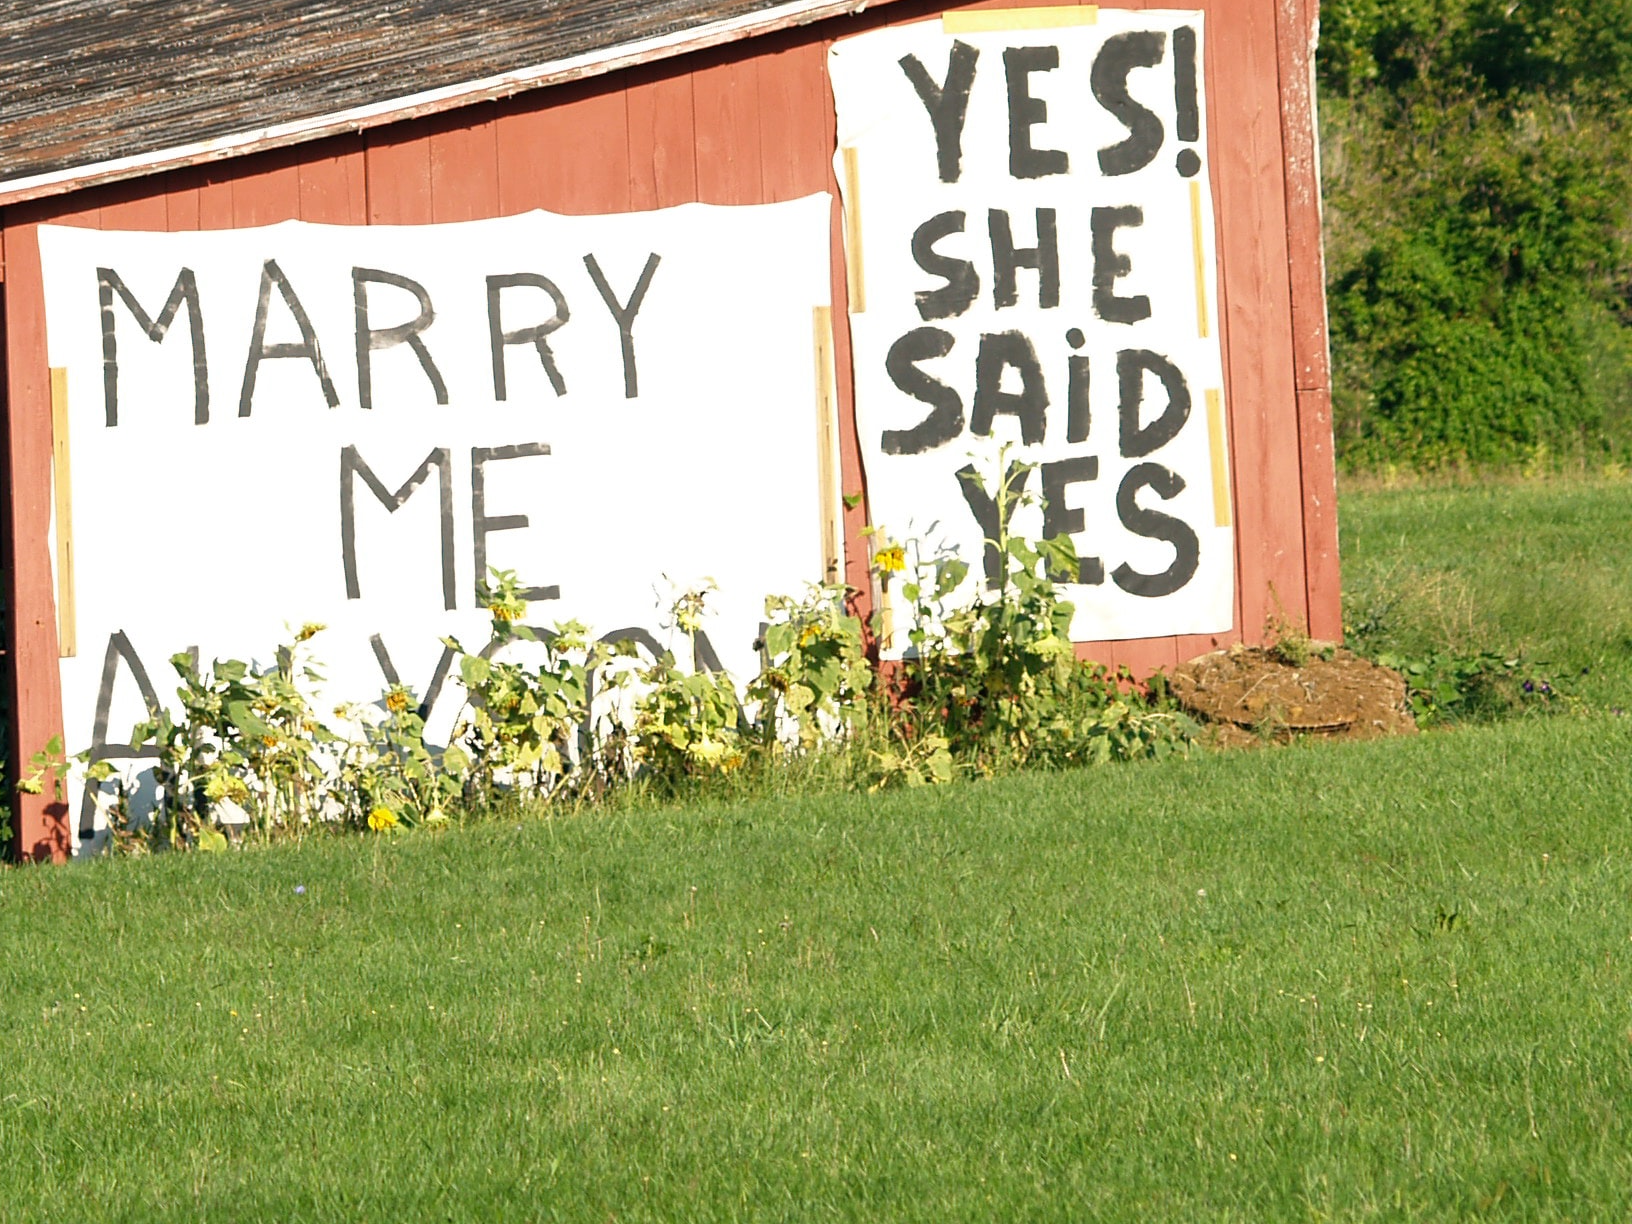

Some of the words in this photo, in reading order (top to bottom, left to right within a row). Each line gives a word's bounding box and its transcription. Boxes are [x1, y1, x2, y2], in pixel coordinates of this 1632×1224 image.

[898, 26, 1200, 182] YES!
[97, 253, 661, 427] MARRY
[911, 205, 1151, 324] SHE
[340, 443, 560, 611] ME
[955, 455, 1200, 597] YES
